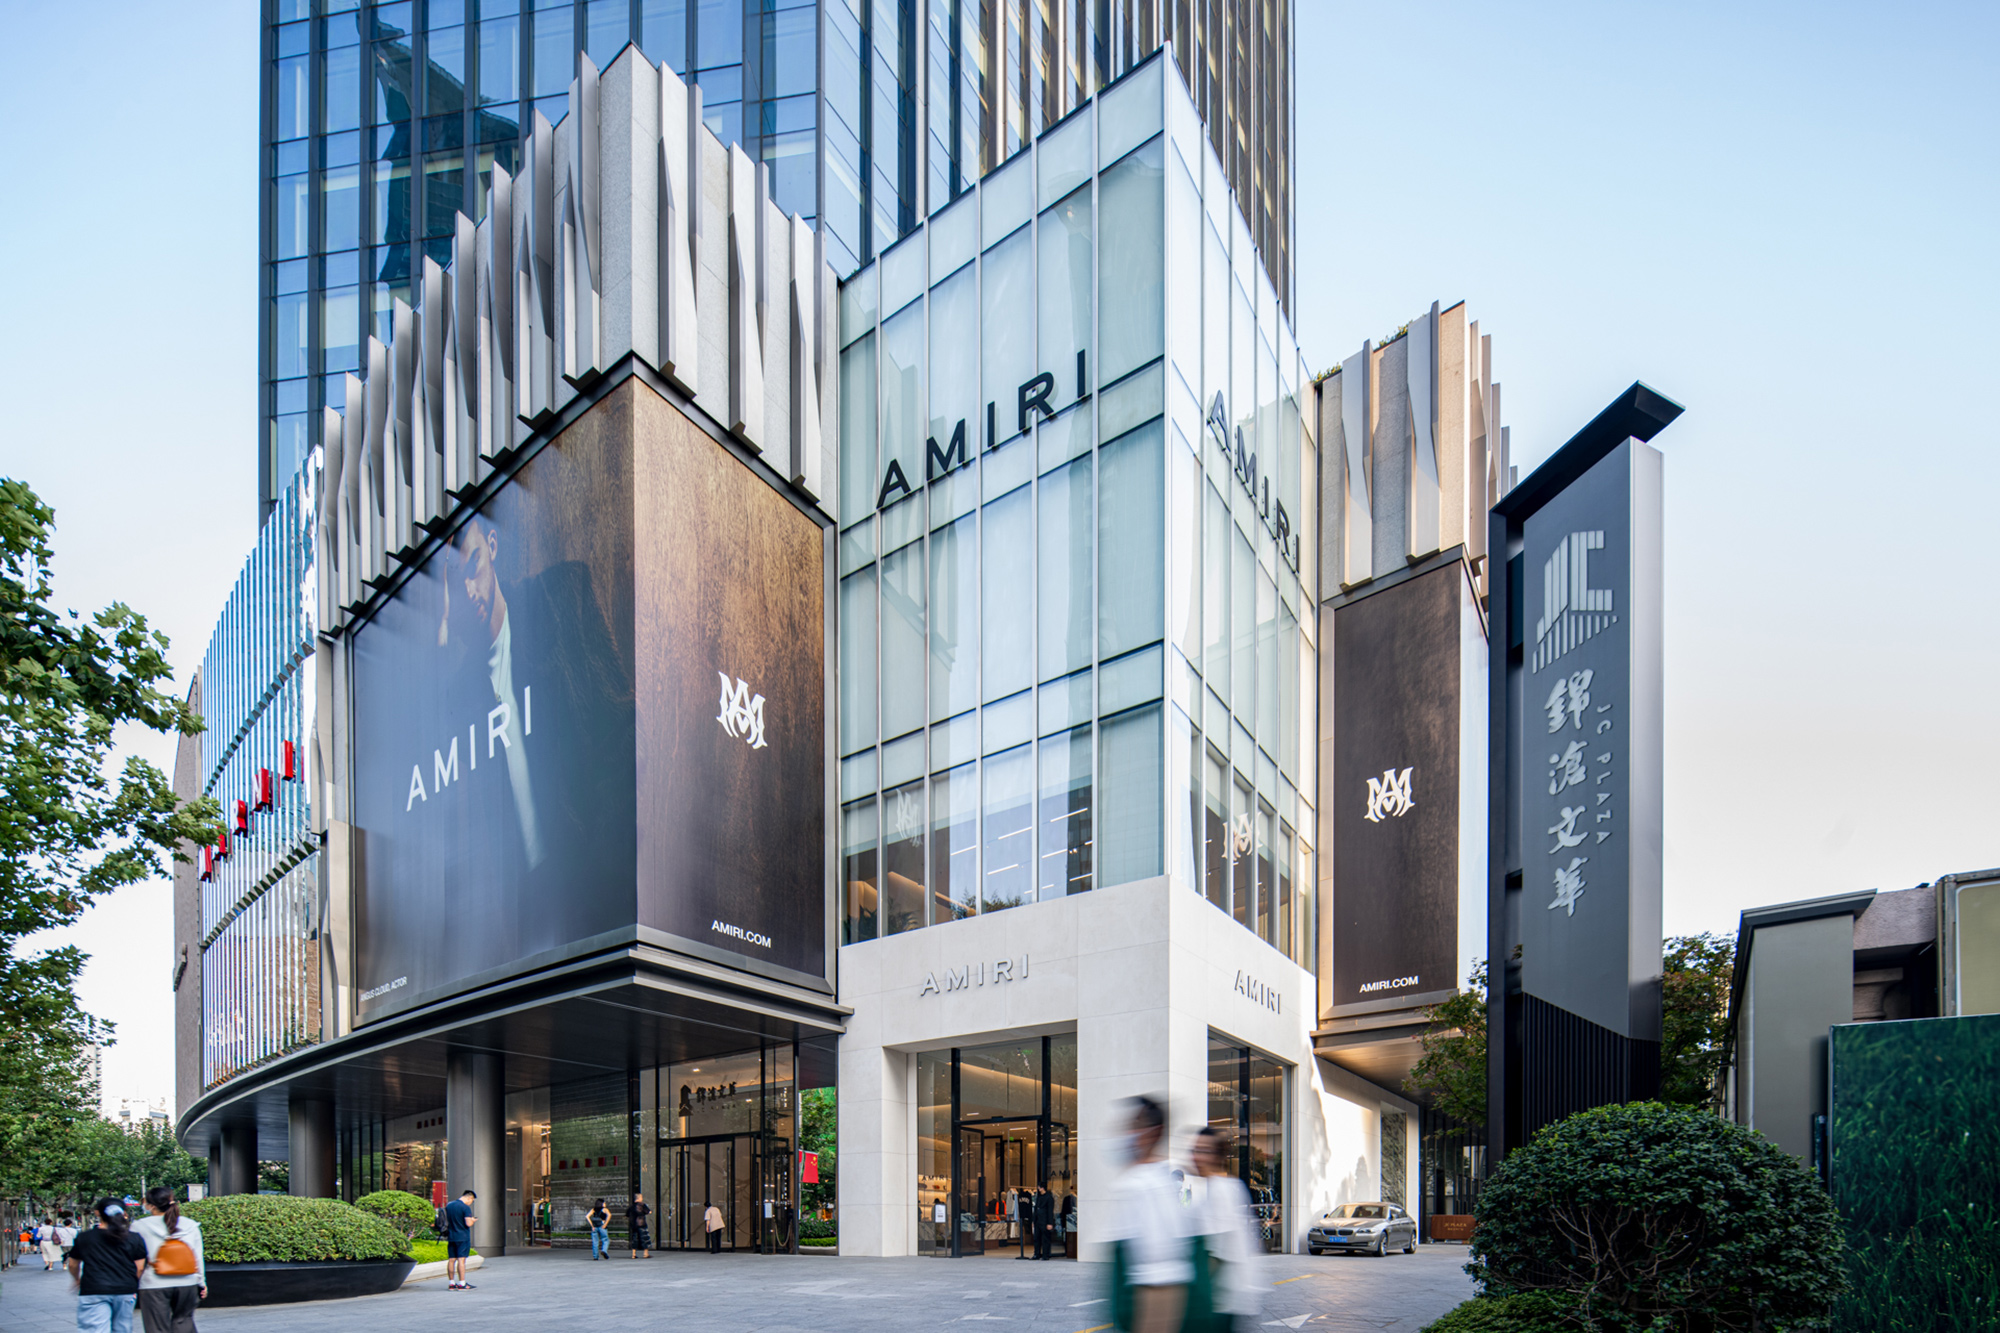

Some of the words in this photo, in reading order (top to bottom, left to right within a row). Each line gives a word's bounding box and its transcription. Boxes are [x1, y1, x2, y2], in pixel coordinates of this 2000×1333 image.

[876, 348, 1086, 510] AMIRI
[1209, 389, 1300, 574] AMIRI
[1596, 703, 1613, 735] JC
[405, 685, 533, 813] AMIRI
[1596, 751, 1613, 845] PLAZA
[711, 919, 772, 948] AMIRI.COM
[390, 976, 408, 990] ACTOR
[920, 953, 1030, 997] AMIRI
[1233, 969, 1282, 1015] AMIRI
[1359, 975, 1419, 994] AMIRI.COM
